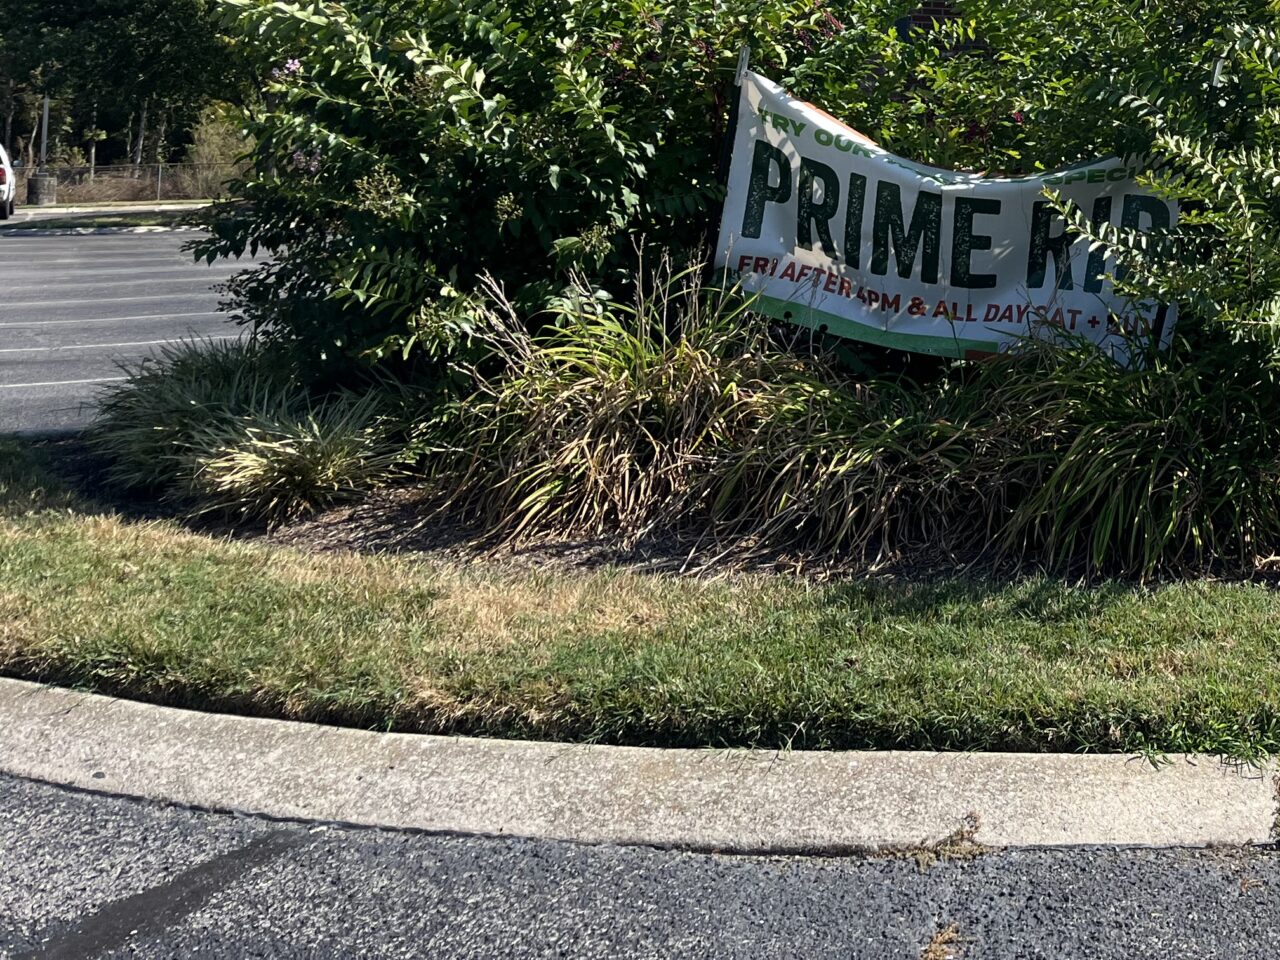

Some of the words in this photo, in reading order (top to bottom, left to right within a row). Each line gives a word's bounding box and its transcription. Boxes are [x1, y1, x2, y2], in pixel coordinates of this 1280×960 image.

[758, 106, 807, 138] TRY
[741, 139, 1003, 290] PRIME
[738, 254, 780, 277] FRI
[778, 261, 852, 299] AFTER
[856, 285, 902, 314] 4PM
[907, 296, 926, 317] &
[931, 300, 978, 323] ALL
[982, 303, 1031, 324] DAY
[1087, 315, 1100, 329] +
